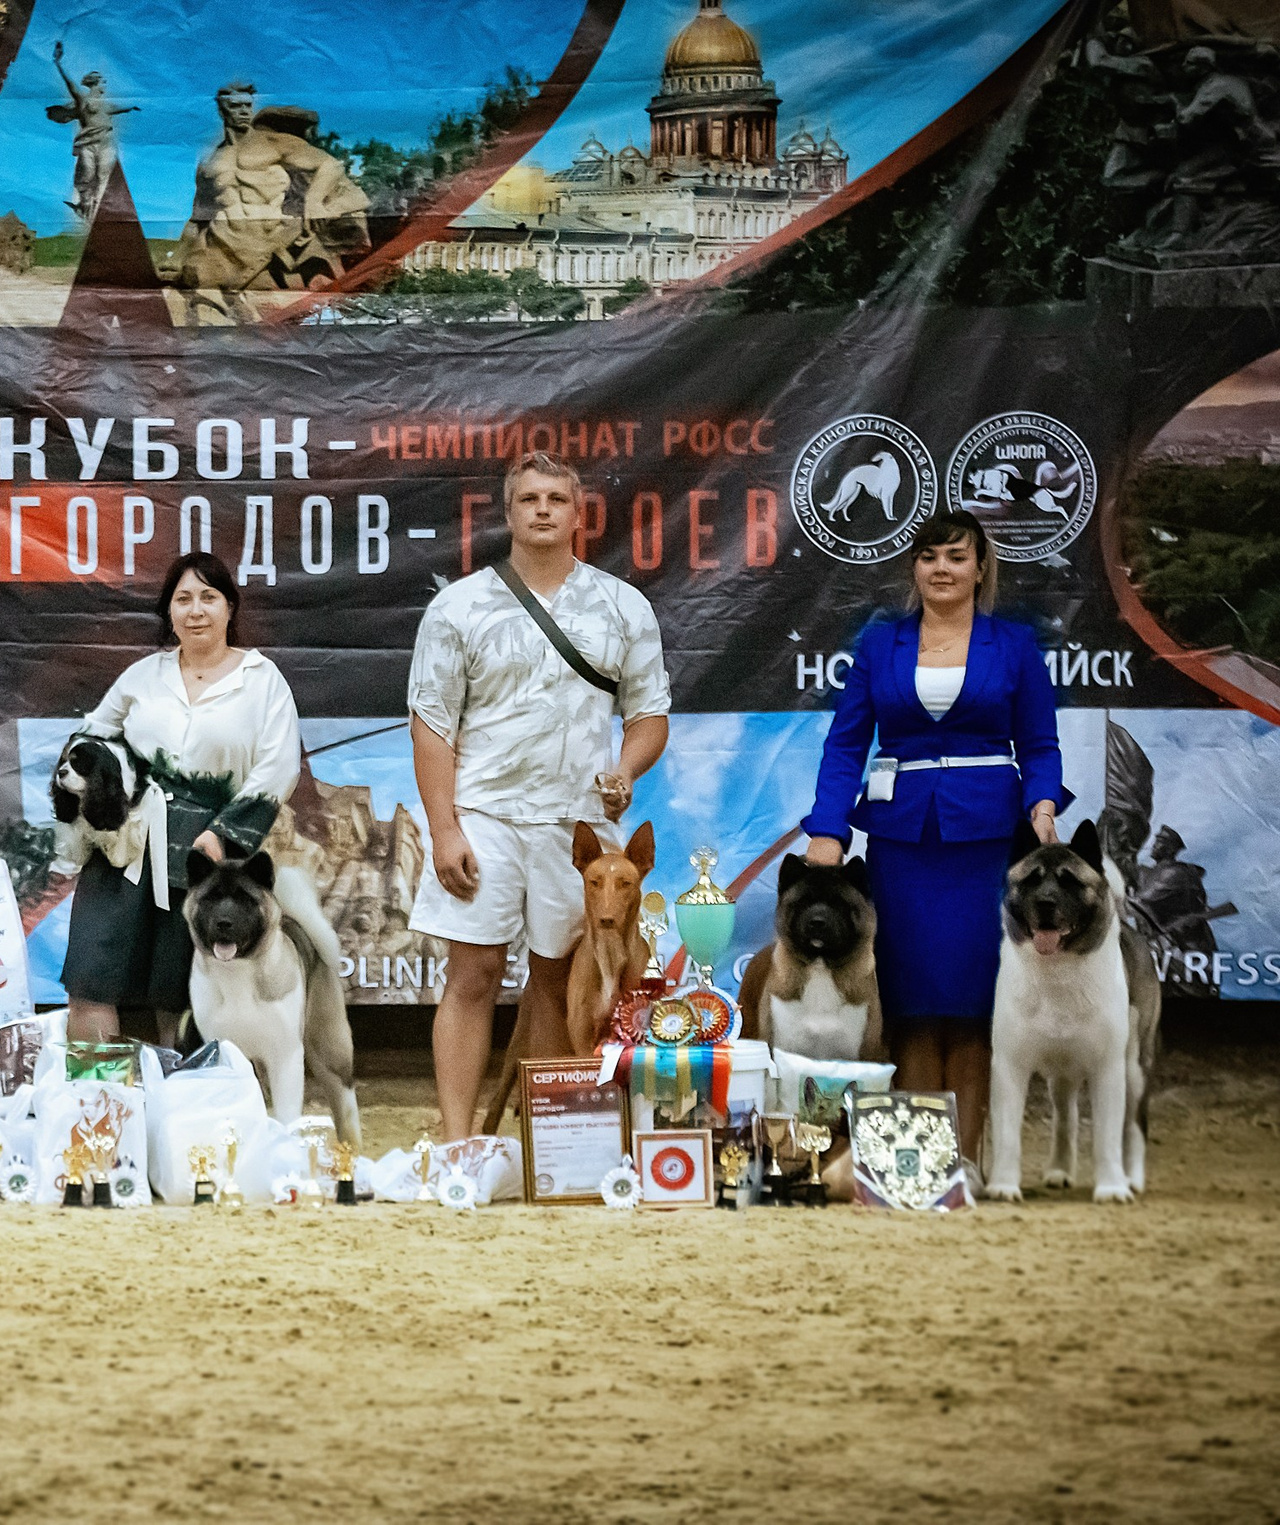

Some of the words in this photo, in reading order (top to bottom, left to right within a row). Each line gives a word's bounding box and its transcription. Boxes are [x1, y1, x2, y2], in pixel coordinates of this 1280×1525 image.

[370, 420, 642, 461] ЧЕМПИОНАТ
[662, 418, 776, 458] РФСС
[809, 418, 928, 466] КИНОЛОГИЧЕСКАЯ
[994, 443, 1047, 460] ШКОЛА
[795, 457, 836, 549] РОССИЙСКАЯ
[891, 469, 934, 549] ФЕДЕРАЦИЯ
[461, 488, 778, 574] ГРОЕВ
[532, 1069, 600, 1085] СЕРТИФИК
